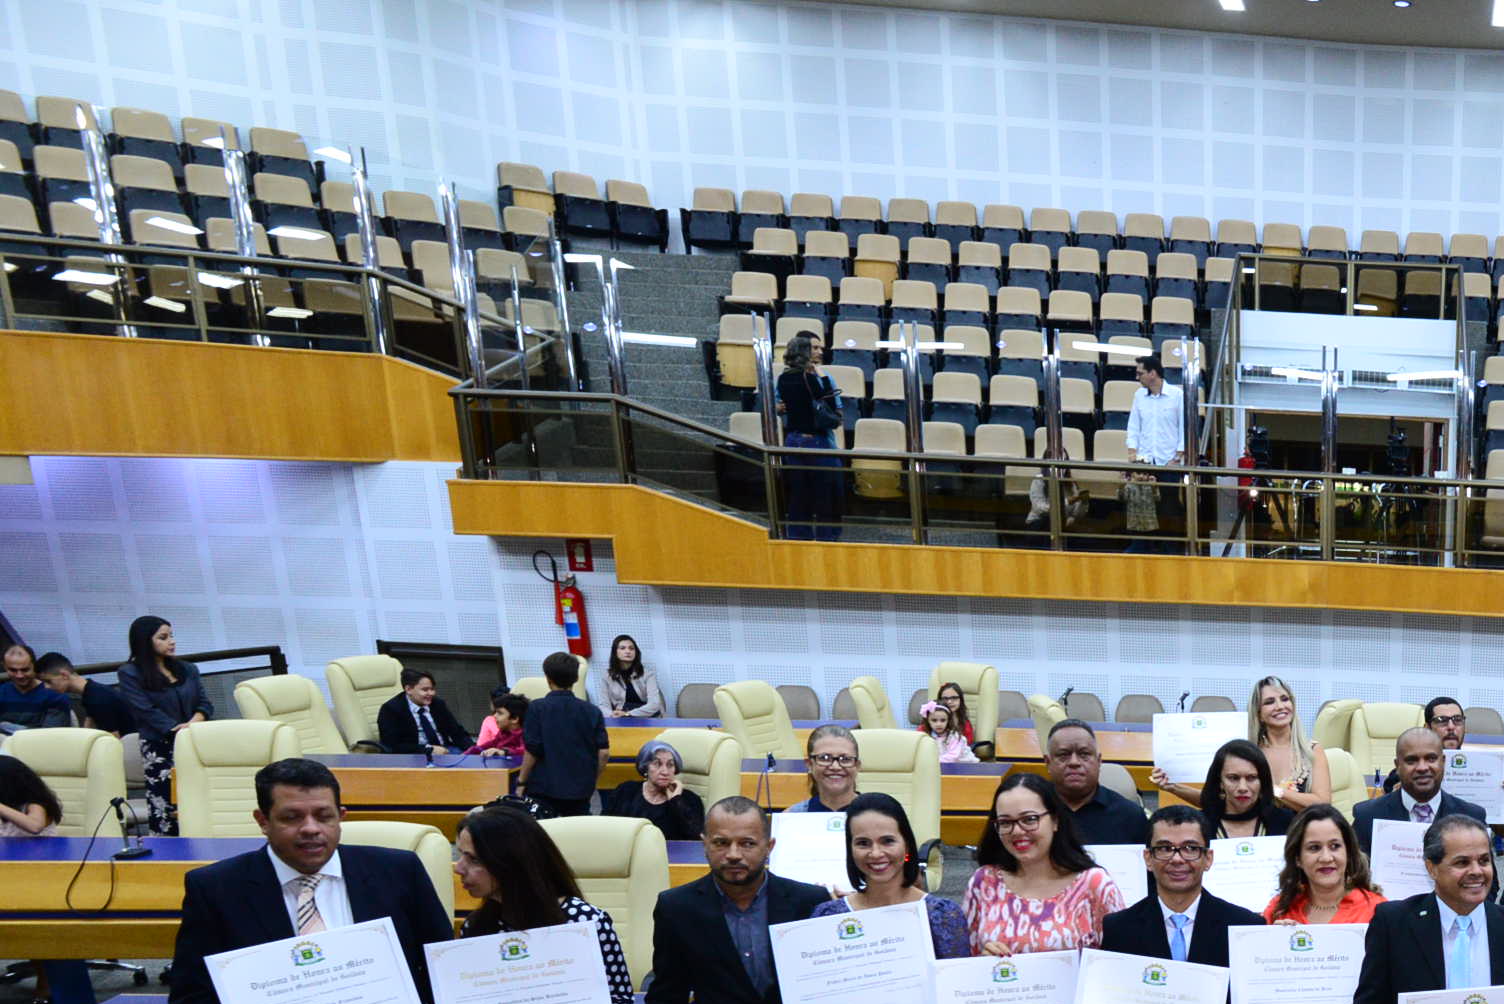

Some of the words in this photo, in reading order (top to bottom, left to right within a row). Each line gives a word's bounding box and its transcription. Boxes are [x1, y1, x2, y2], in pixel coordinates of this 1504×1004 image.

[800, 949, 832, 959] Diploma
[844, 943, 867, 952] Honra
[880, 936, 905, 946] Mérito
[250, 977, 288, 991] Diploma
[289, 974, 300, 982] de
[302, 968, 330, 979] Honra
[345, 957, 374, 969] Mérito
